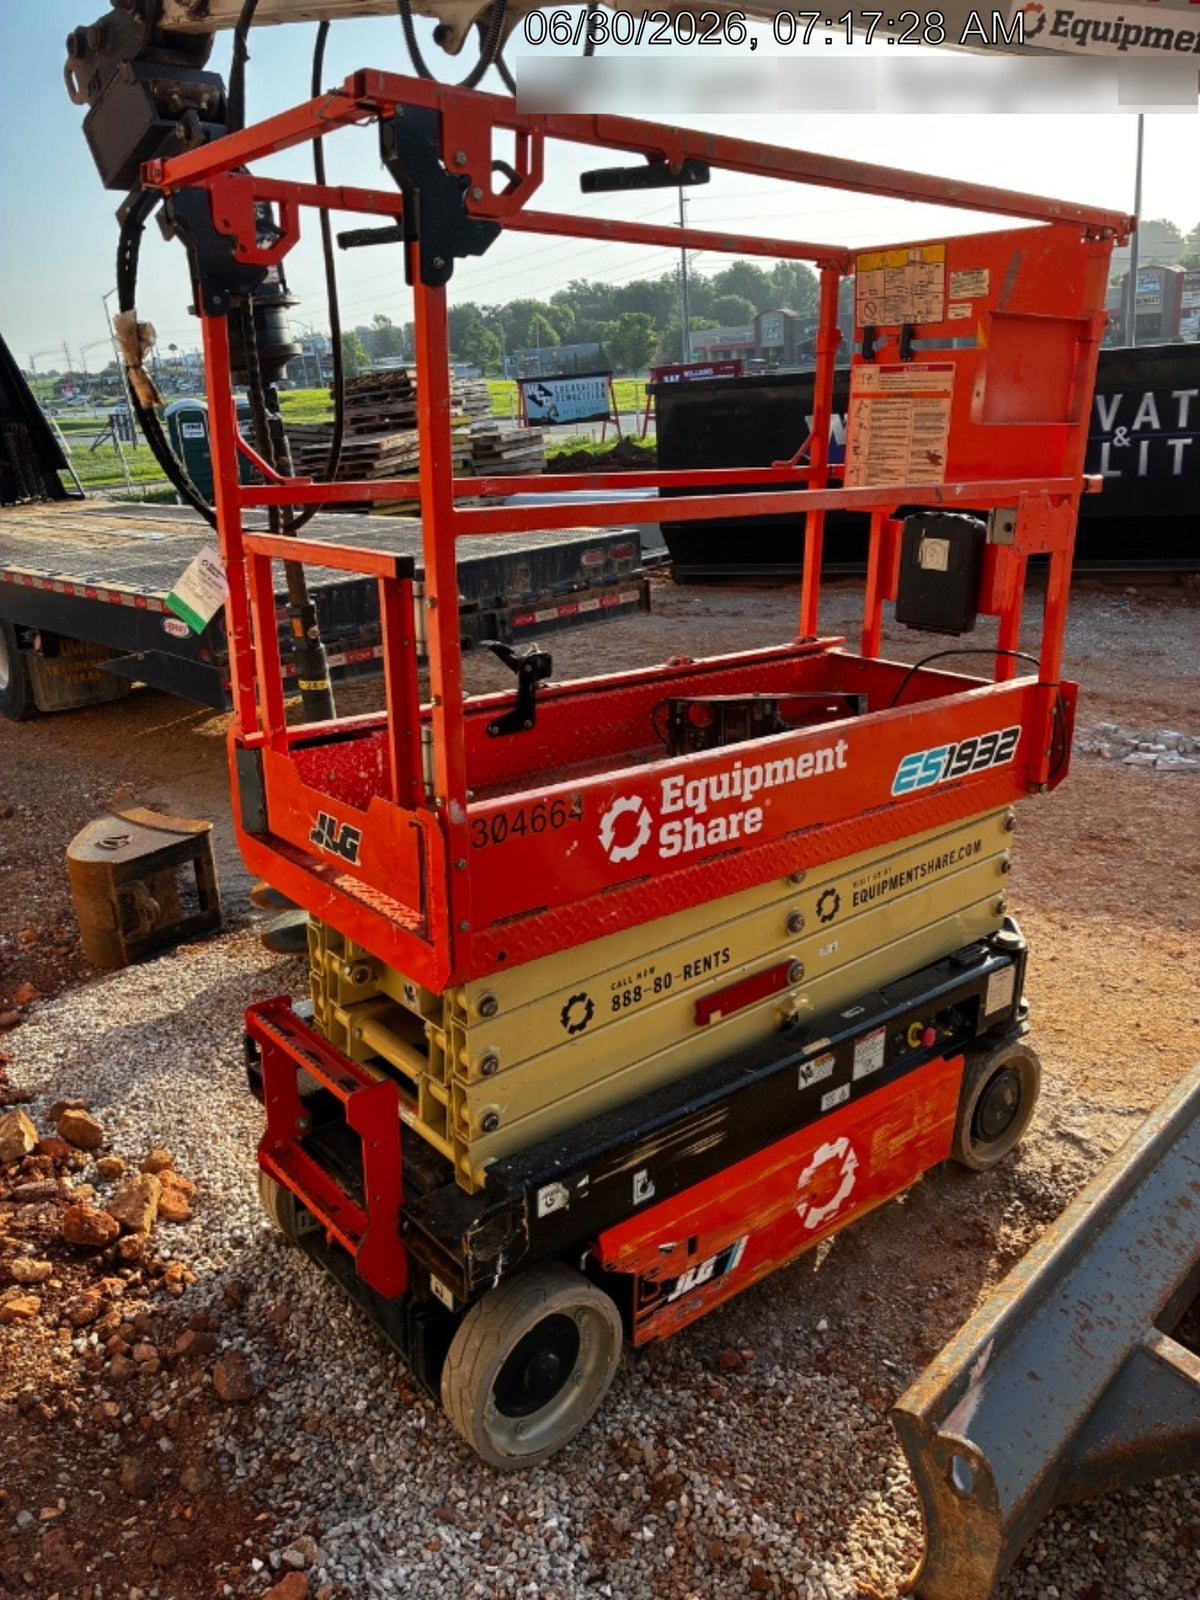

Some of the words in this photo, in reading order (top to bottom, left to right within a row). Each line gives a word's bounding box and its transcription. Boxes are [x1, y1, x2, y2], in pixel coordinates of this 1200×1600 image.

[1050, 9, 1200, 54] Equipme
[659, 739, 848, 815] Equipment
[891, 725, 1022, 797] ES1932
[309, 810, 362, 866] JLG
[470, 793, 584, 850] 304664
[658, 806, 764, 858] Share
[852, 838, 982, 907] EQUIPMENTSHARE.COM
[611, 976, 633, 991] CALL
[636, 966, 656, 980] NOW
[668, 1255, 718, 1303] JLG
